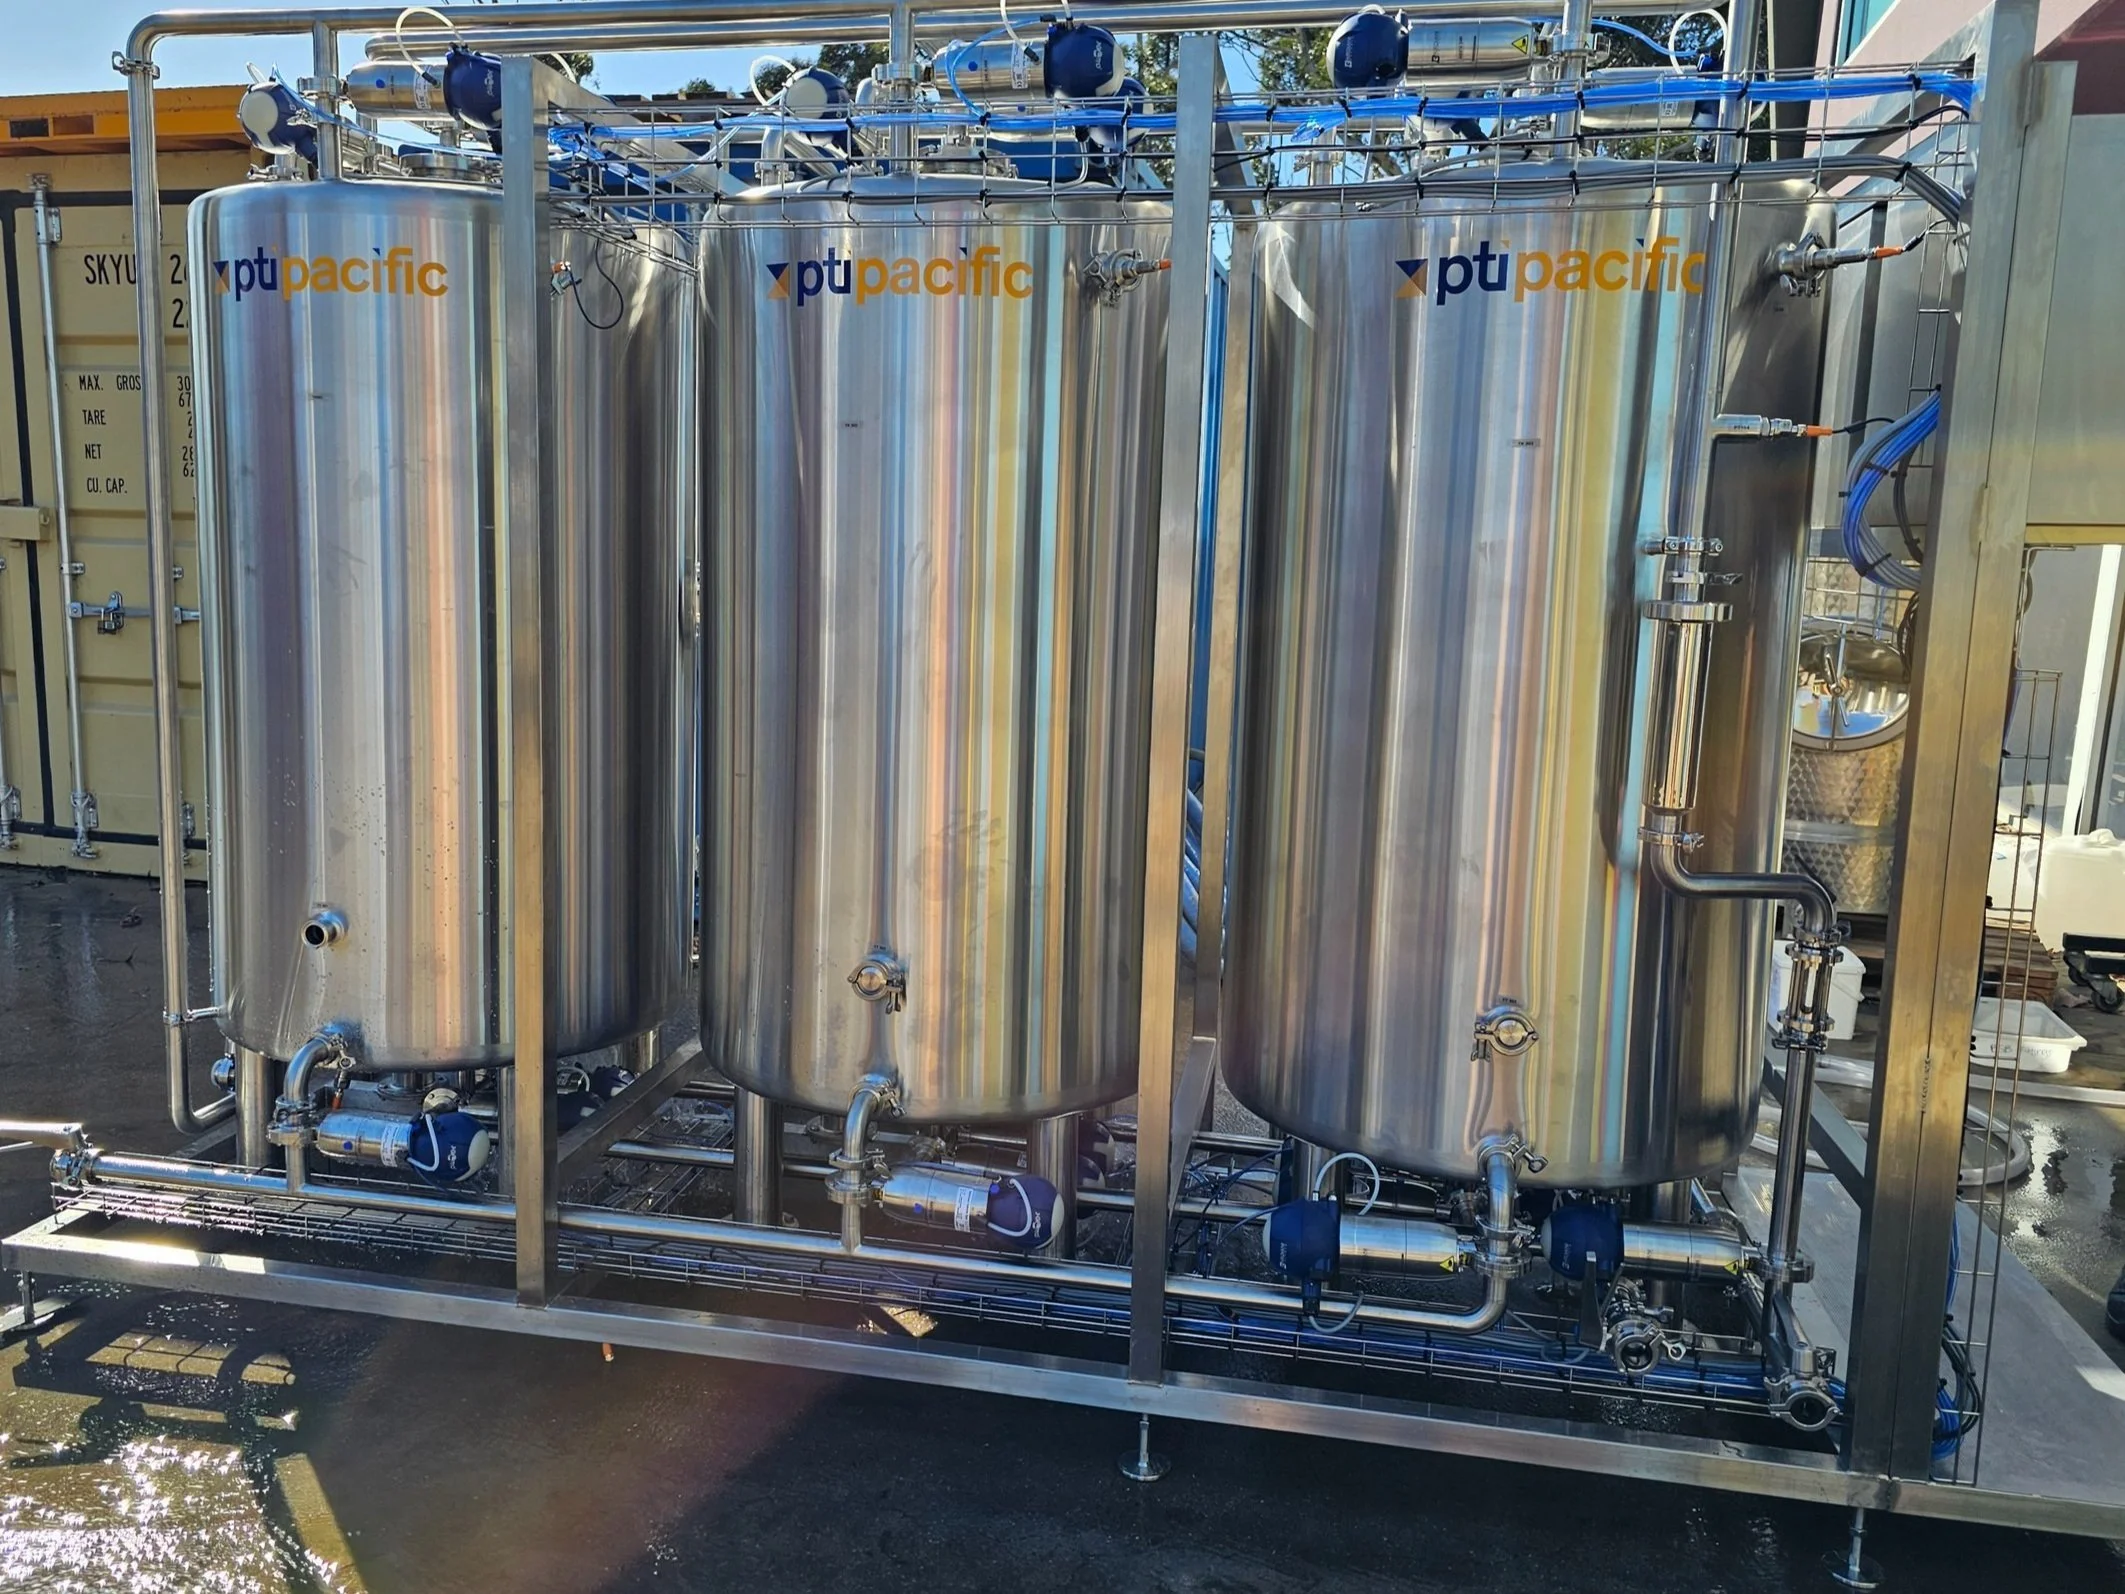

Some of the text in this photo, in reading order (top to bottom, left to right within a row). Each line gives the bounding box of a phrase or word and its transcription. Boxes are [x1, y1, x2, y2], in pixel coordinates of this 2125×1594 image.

[83, 253, 137, 285] SKYU
[172, 297, 189, 328] 2
[79, 375, 104, 391] MAX.
[82, 409, 107, 425] TARE
[84, 444, 102, 459] NET
[86, 478, 128, 494] CU. CAP.
